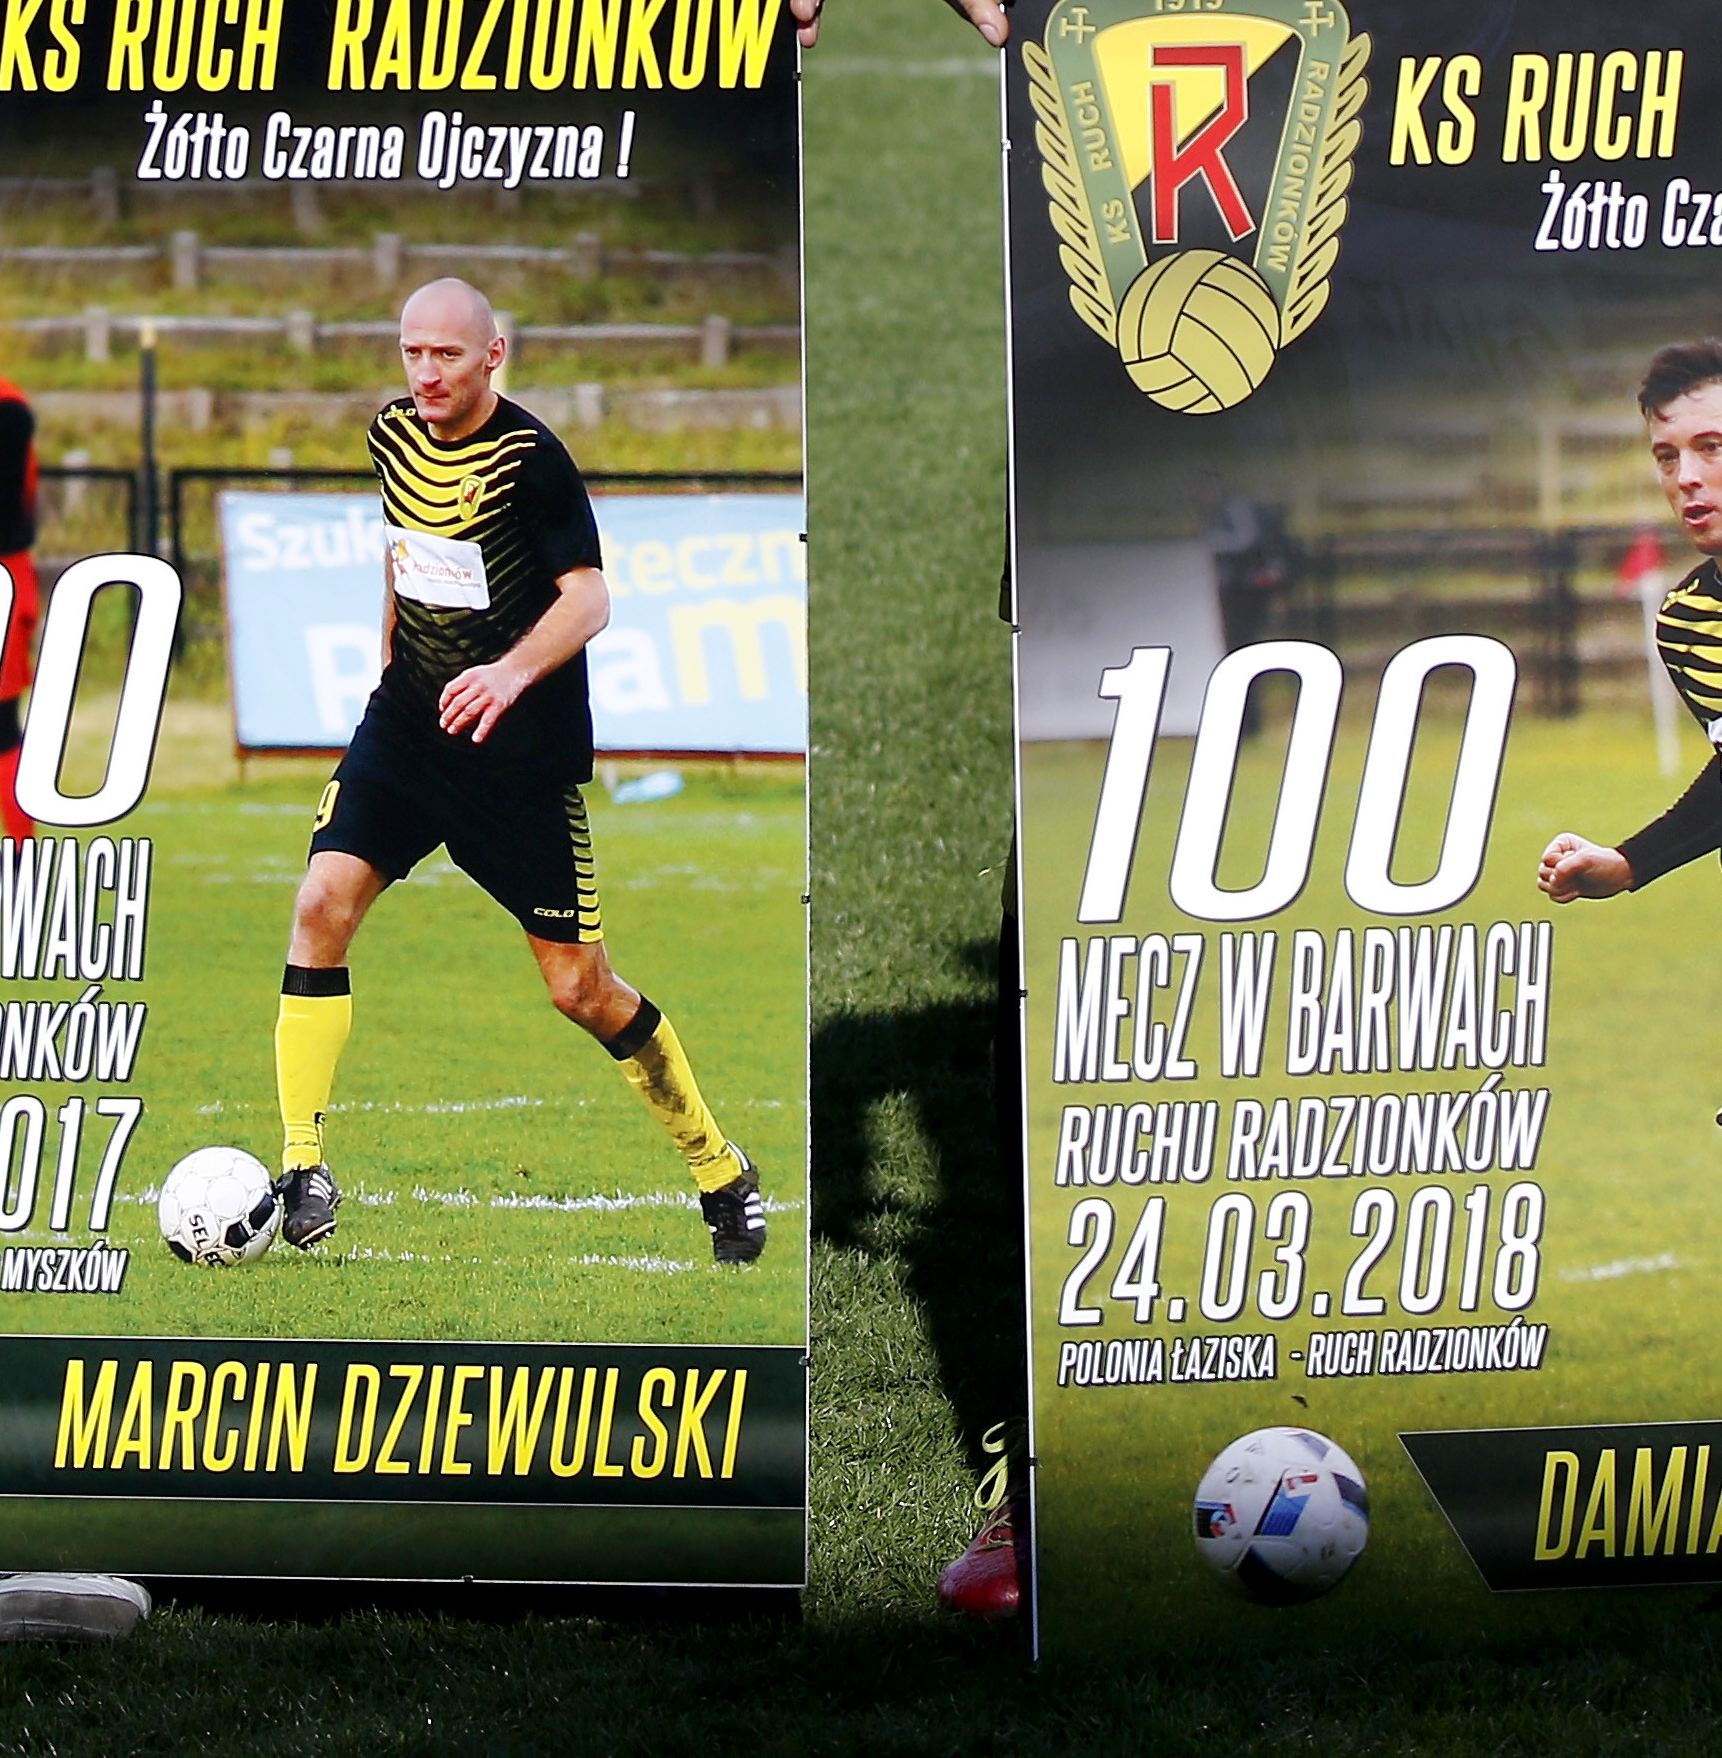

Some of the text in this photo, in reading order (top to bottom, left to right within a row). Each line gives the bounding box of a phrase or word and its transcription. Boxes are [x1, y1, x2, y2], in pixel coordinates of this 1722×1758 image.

[137, 98, 251, 181] Żółto
[262, 109, 405, 181] Czarna
[416, 109, 605, 191] Ojczyzna
[1071, 80, 1133, 245] KS RUCH
[1270, 59, 1332, 273] RADZIONKÓW
[1389, 54, 1482, 167] KS
[1501, 48, 1686, 163] RUCH
[1535, 169, 1648, 253] Żółto
[1077, 633, 1518, 924] 100
[533, 907, 575, 918] COLO
[1053, 921, 1553, 1083] MECZ W BARWACH
[1055, 1072, 1550, 1186] RUCHU RADZIONKÓW
[0, 1240, 129, 1293] MYSZKÓW
[1059, 1181, 1546, 1327] 24.03.2018
[1058, 1339, 1163, 1387] POLONIA
[1170, 1335, 1276, 1383] ŁAZISKA
[1305, 1331, 1373, 1377] RUCH
[1378, 1316, 1547, 1374] RADZIONKÓW
[53, 1359, 748, 1480] MARCIN DZIEWULSKI
